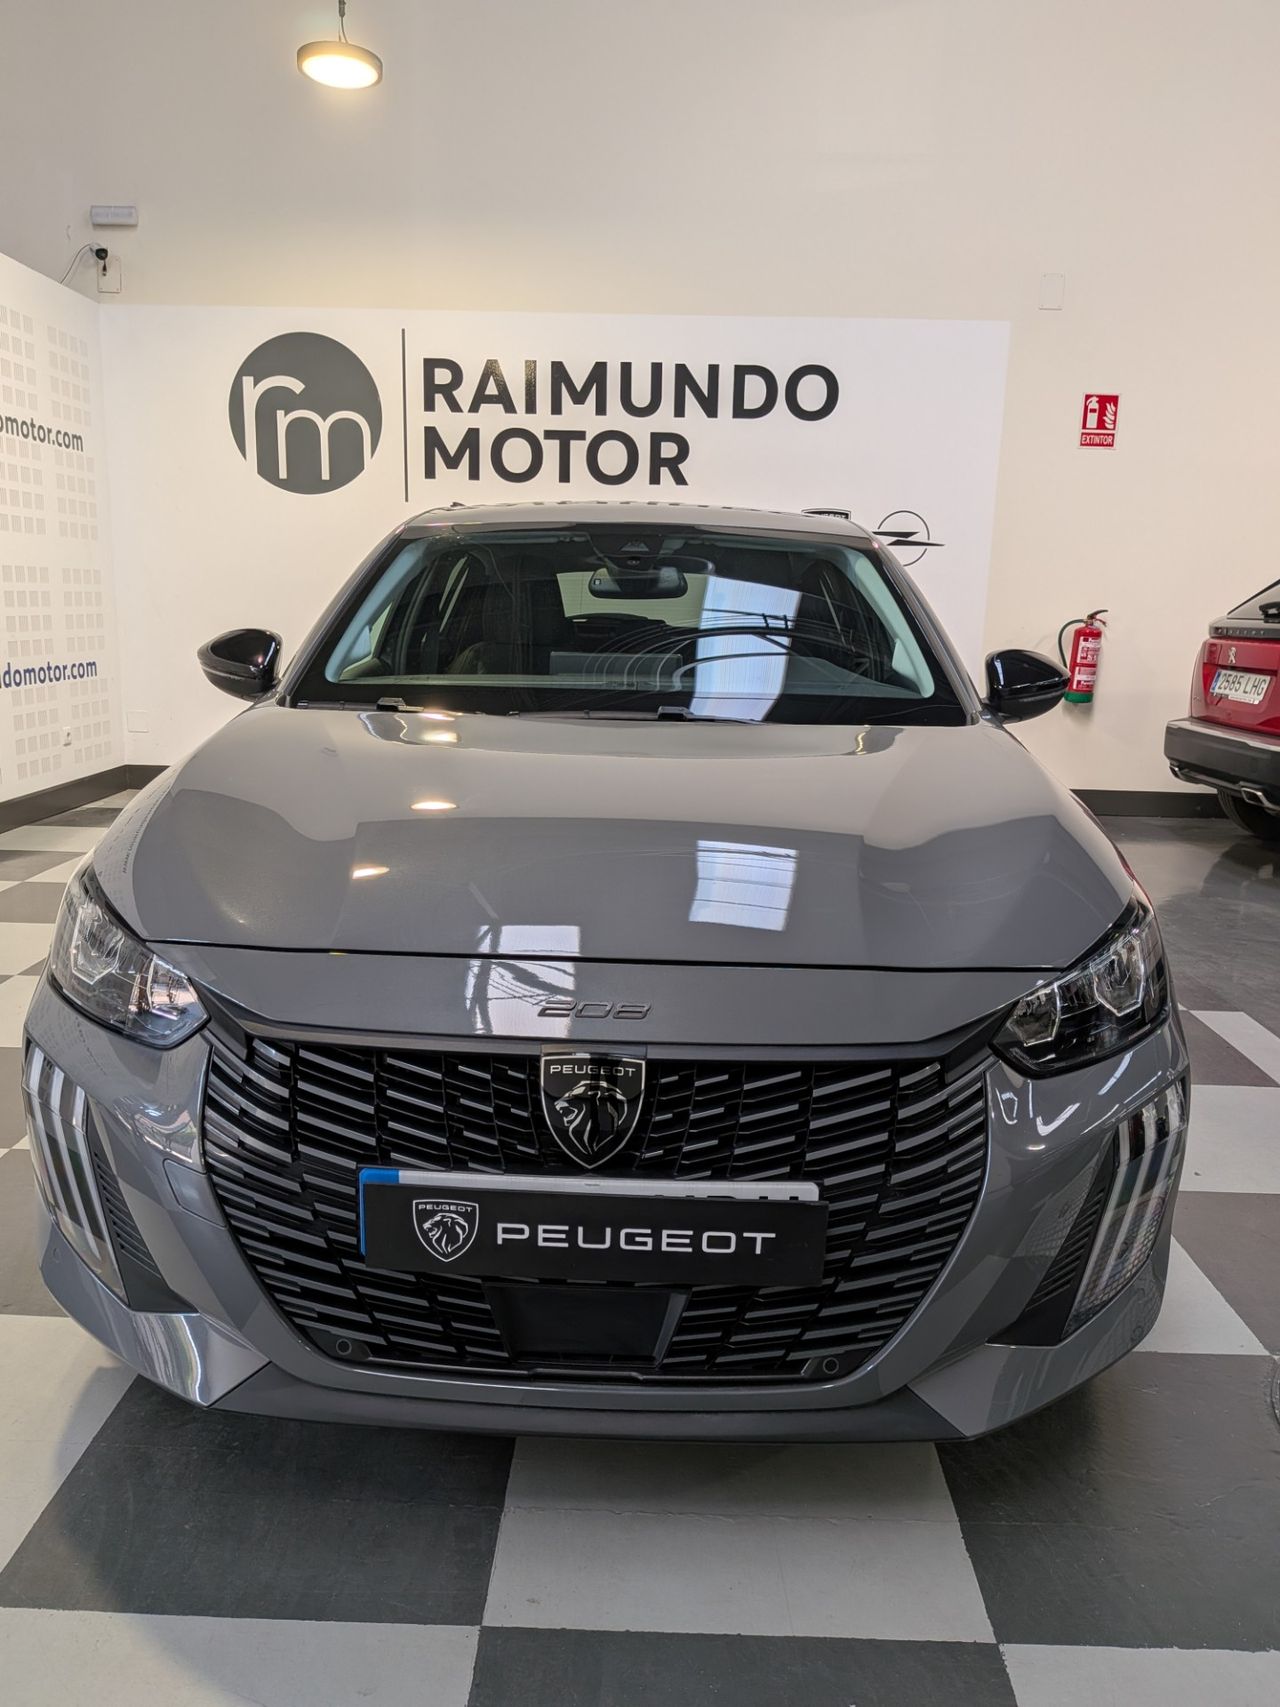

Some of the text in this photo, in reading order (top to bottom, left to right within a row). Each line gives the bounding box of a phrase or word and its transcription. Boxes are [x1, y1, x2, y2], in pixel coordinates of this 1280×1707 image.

[422, 357, 840, 422] RAIMUNDO
[1081, 434, 1114, 446] EXTINTOR
[424, 426, 691, 487] MOTOR
[0, 661, 97, 688] domotor.com
[1217, 672, 1244, 692] 2585
[537, 999, 652, 1020] 208
[549, 1064, 637, 1078] PEUGEOT
[418, 1203, 473, 1213] PEUGEOT
[496, 1222, 777, 1256] PEUGEOT
